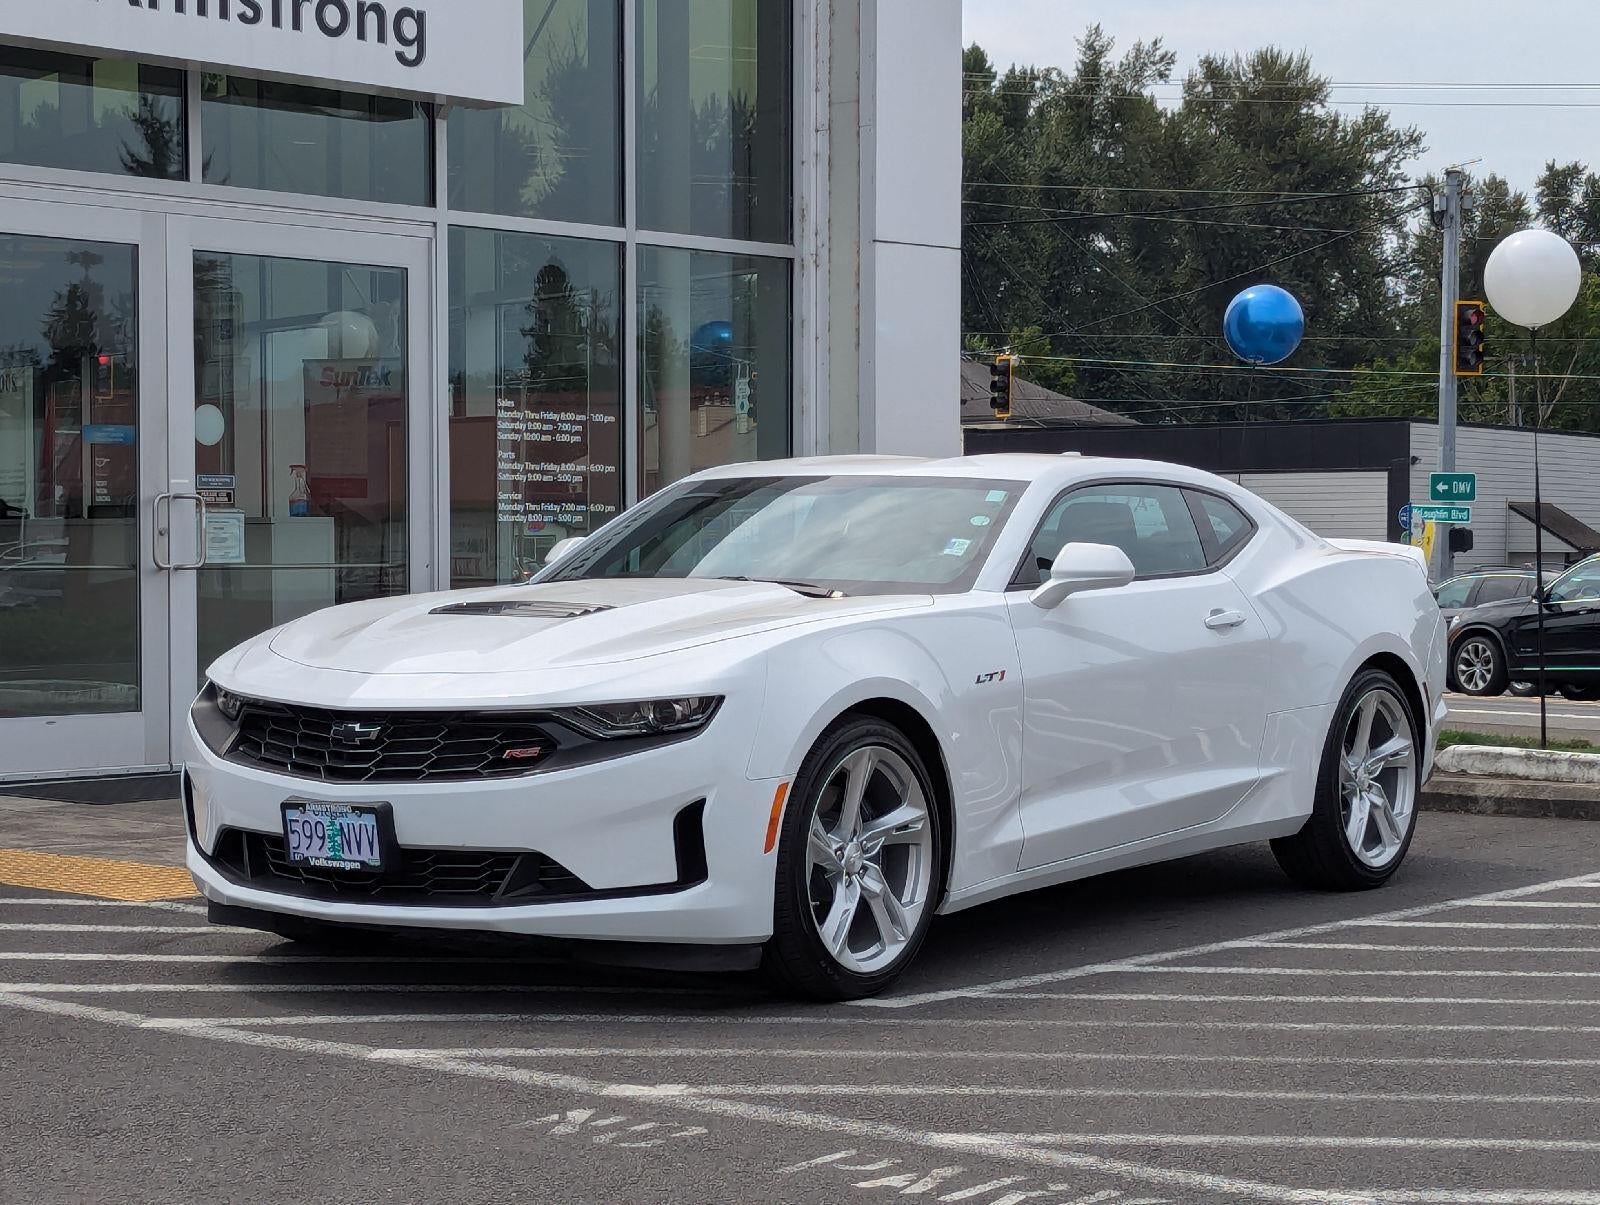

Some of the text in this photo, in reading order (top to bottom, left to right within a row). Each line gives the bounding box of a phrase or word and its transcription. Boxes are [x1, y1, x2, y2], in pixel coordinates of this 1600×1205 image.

[498, 399, 515, 407] Sales
[498, 409, 524, 420] Monday
[525, 411, 540, 419] Thru
[541, 411, 560, 421] Friday
[497, 421, 526, 431] Saturday
[497, 432, 522, 441] Sunday
[498, 450, 516, 459] Parts
[498, 461, 524, 472] Monday
[525, 462, 540, 470] Thru
[541, 463, 560, 472] Friday
[498, 472, 527, 482] Saturday
[1453, 481, 1471, 494] DMV
[498, 492, 522, 500] Service
[499, 502, 525, 512] Monday
[541, 503, 560, 513] Friday
[498, 513, 527, 523] Saturday
[1451, 510, 1468, 520] Blvd
[502, 747, 541, 758] RS
[288, 818, 376, 857] 599 NVV
[309, 856, 361, 870] Volkswagen
